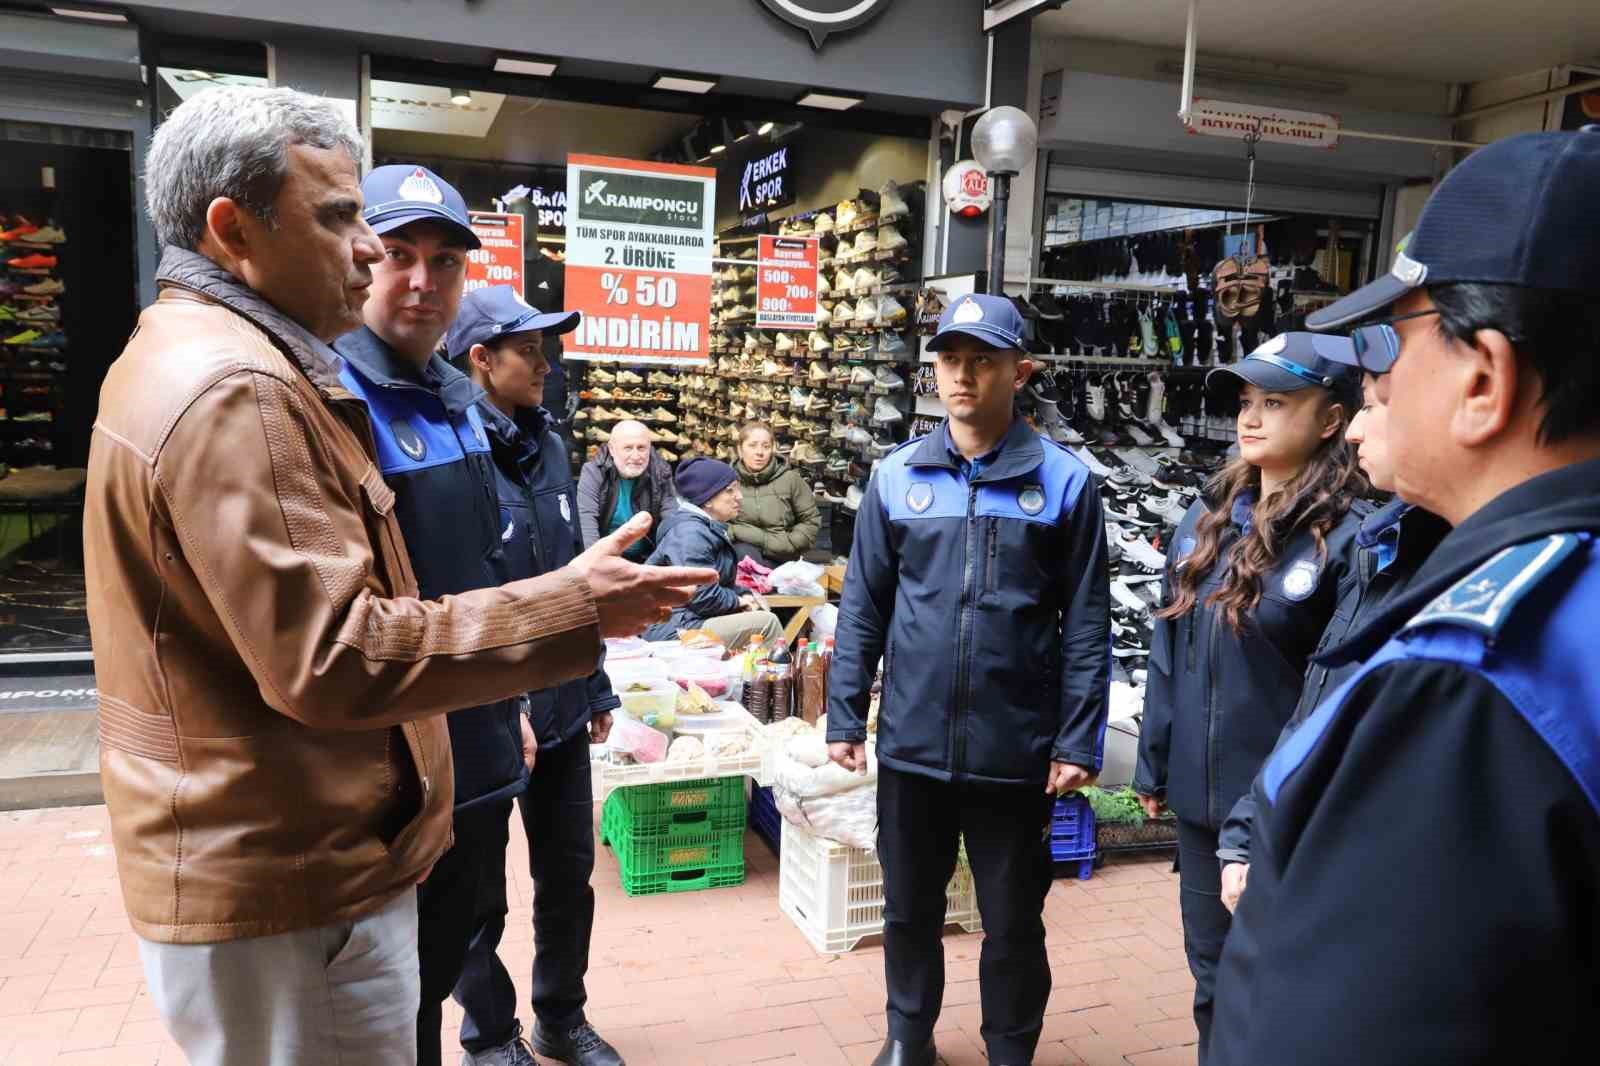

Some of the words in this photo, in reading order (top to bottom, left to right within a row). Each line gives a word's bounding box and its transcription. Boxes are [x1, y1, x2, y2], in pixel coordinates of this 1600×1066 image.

[753, 147, 787, 182] ERKEK
[755, 175, 782, 205] SPOR
[600, 227, 626, 242] SPOR
[628, 231, 704, 247] AYAKKABILARDA
[605, 247, 618, 265] 2.
[623, 244, 676, 269] ÜRÜNE
[600, 272, 629, 305] %
[635, 275, 678, 309] 50
[575, 309, 699, 352] İNDİRİM
